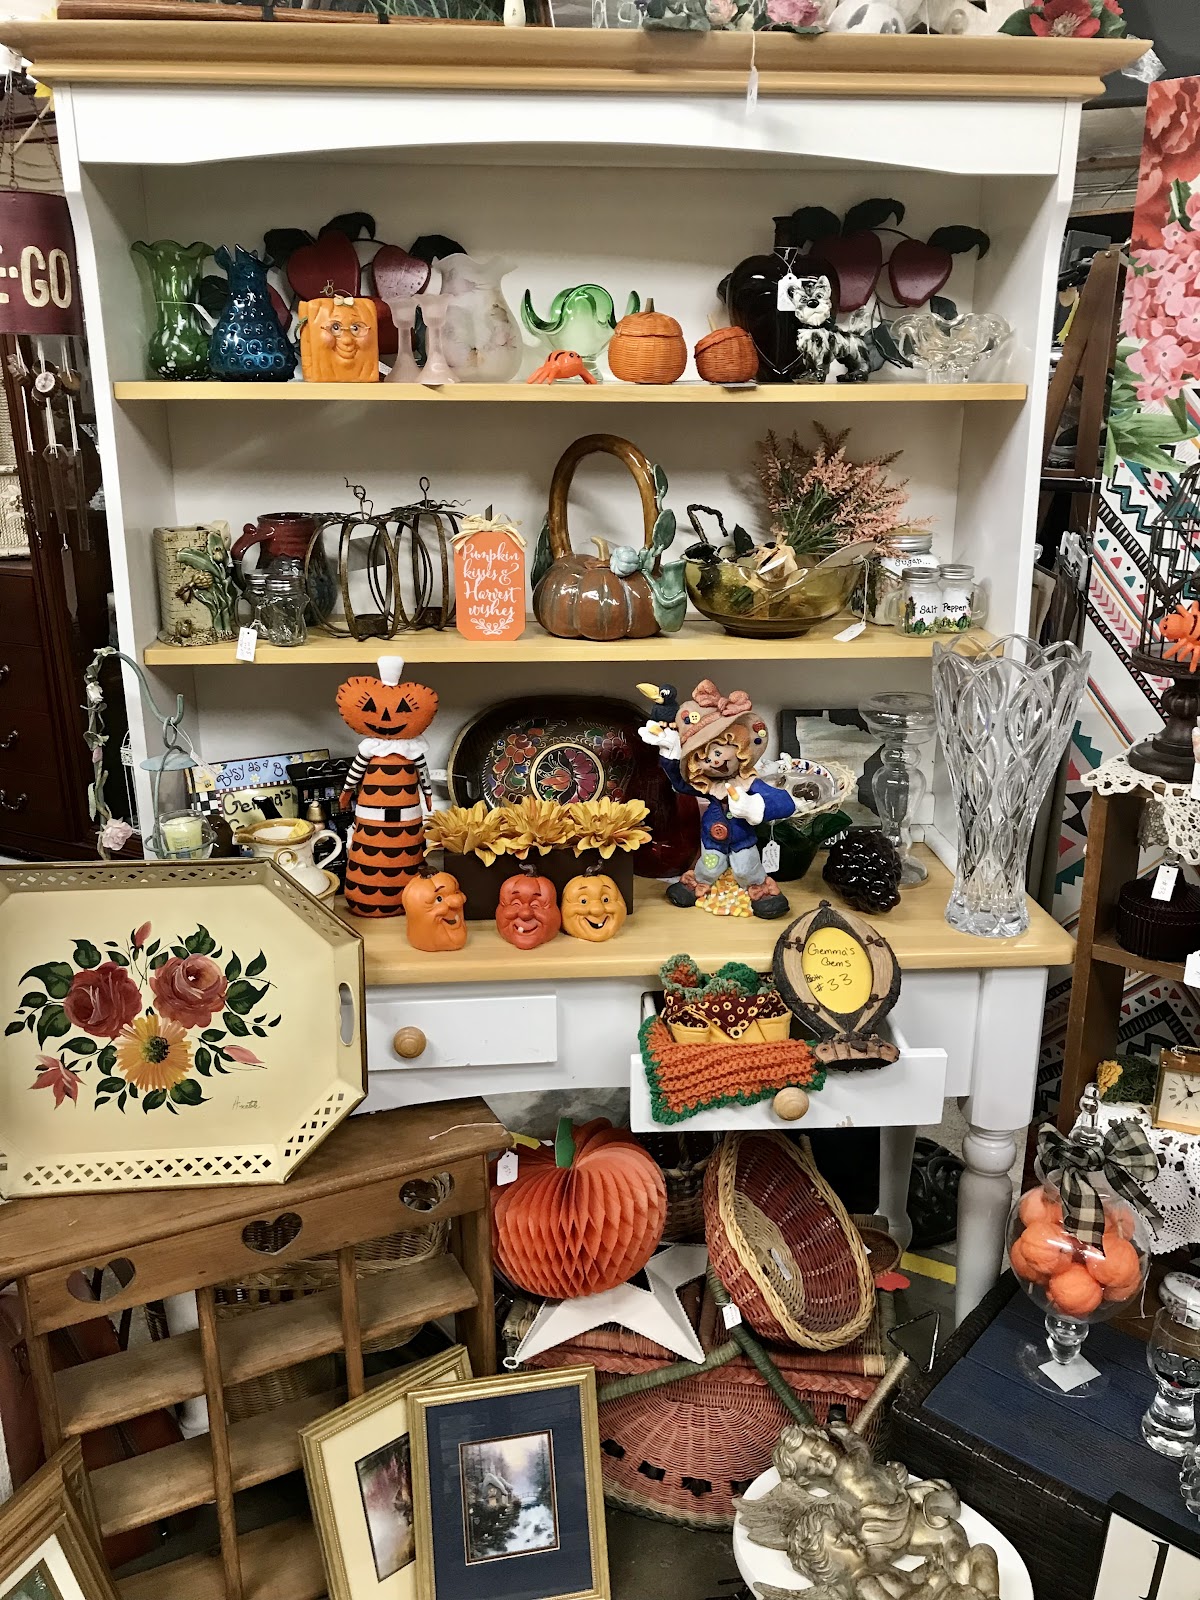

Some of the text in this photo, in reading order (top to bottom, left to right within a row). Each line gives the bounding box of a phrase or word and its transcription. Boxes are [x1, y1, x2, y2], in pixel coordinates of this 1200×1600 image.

[463, 542, 520, 570] Pumpkin
[463, 558, 520, 585] kisses &
[463, 580, 522, 603] Harvest
[468, 599, 516, 619] wishes
[919, 605, 938, 614] Salt
[942, 602, 967, 613] Pepper
[216, 765, 245, 787] Busy
[248, 761, 261, 772] as
[273, 762, 287, 777] B
[222, 788, 292, 816] Gea's
[807, 942, 856, 956] Gemma's
